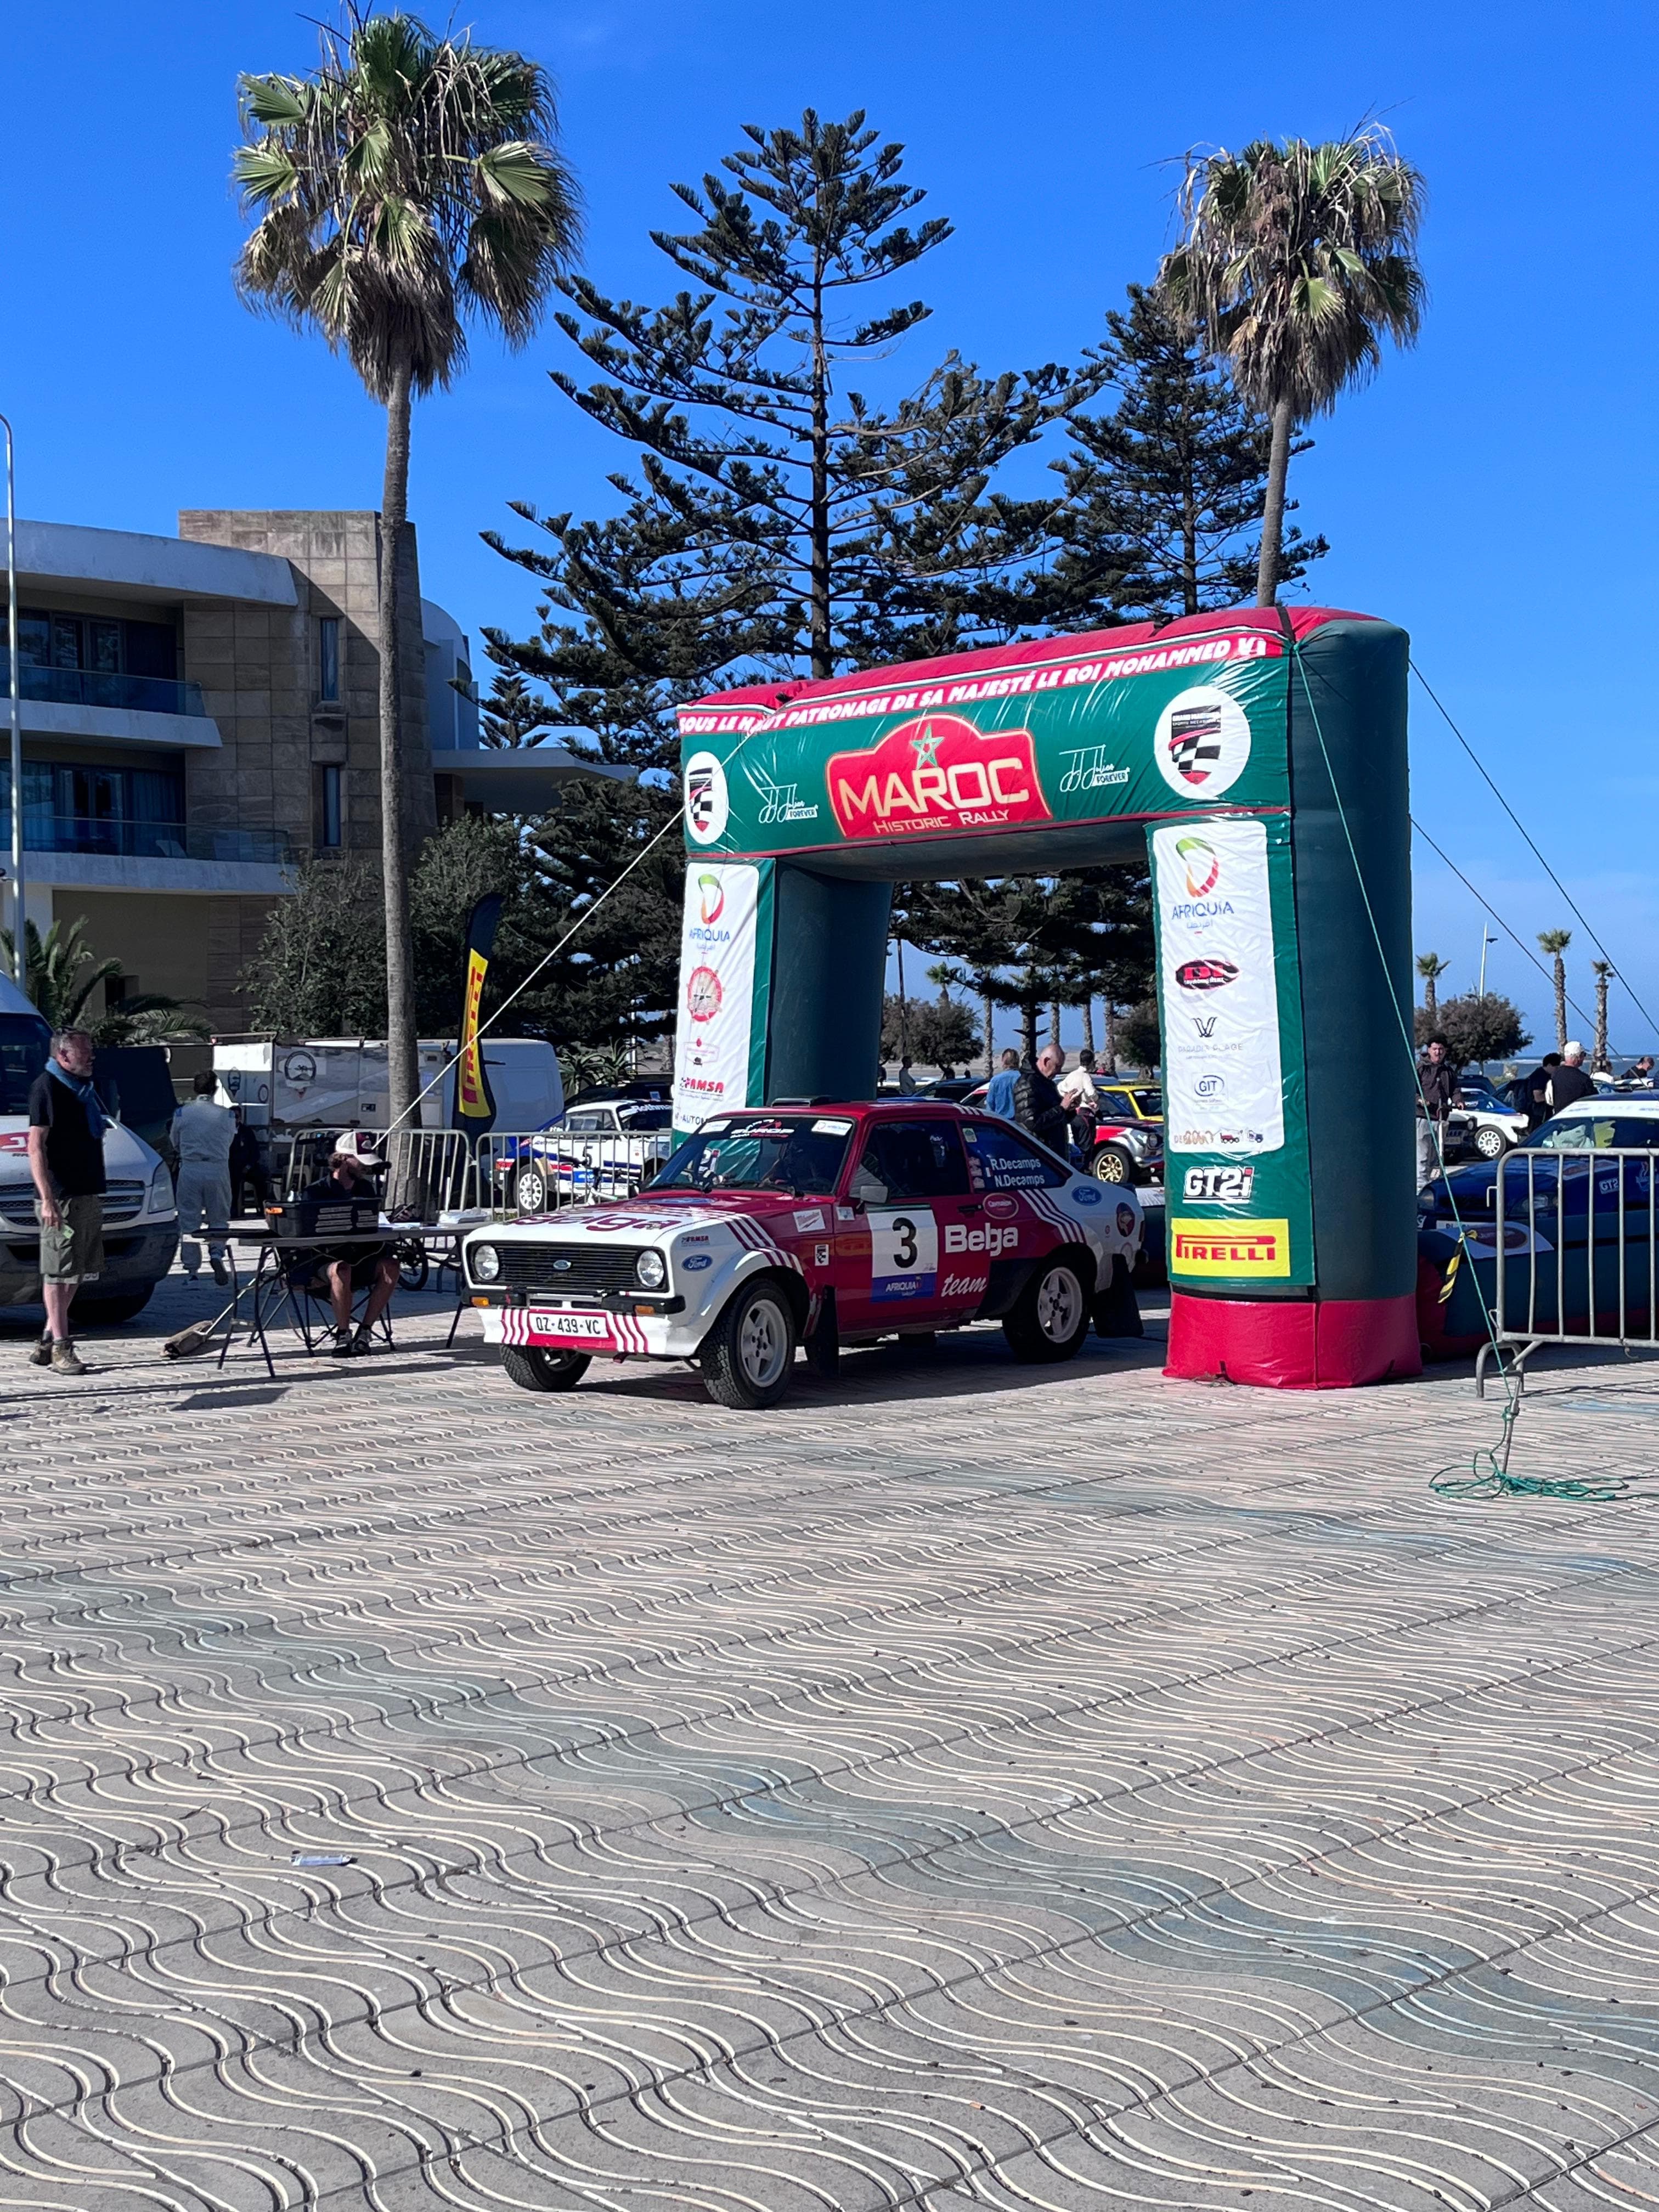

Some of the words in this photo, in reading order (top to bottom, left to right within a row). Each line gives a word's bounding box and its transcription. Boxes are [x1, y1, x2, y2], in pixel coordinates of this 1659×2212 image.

[718, 715, 739, 731] LE
[785, 697, 891, 727] PATRONAGE
[891, 692, 918, 710] DE
[918, 689, 944, 707] SA
[947, 664, 1037, 703] MAJESTÉ
[1036, 670, 1063, 689] LE
[1063, 667, 1104, 685] ROI
[1104, 640, 1232, 679] MOHAMMED
[1097, 771, 1126, 784] FOREVER
[838, 757, 1030, 820] MAROC
[789, 808, 815, 818] FOREVER
[873, 816, 951, 833] HISTORIC
[958, 809, 1010, 826] RALLY
[1171, 901, 1234, 920] AFRIQUIA
[689, 928, 730, 942] AFRIQUIA
[1199, 1080, 1217, 1092] GIT
[631, 1104, 673, 1113] Rothma
[583, 1146, 593, 1168] 5
[990, 1158, 1041, 1171] R.Decamps
[994, 1174, 1045, 1187] N.Decamps
[1185, 1167, 1254, 1197] GT2i
[1601, 1180, 1618, 1191] GT2
[1078, 1189, 1097, 1201] Ford
[892, 1217, 918, 1268] 3
[945, 1222, 1019, 1257] Belga
[1176, 1234, 1276, 1261] PIRELLI
[688, 1257, 708, 1269] Ford
[885, 1281, 917, 1293] AFRIQUIA
[940, 1273, 988, 1297] team
